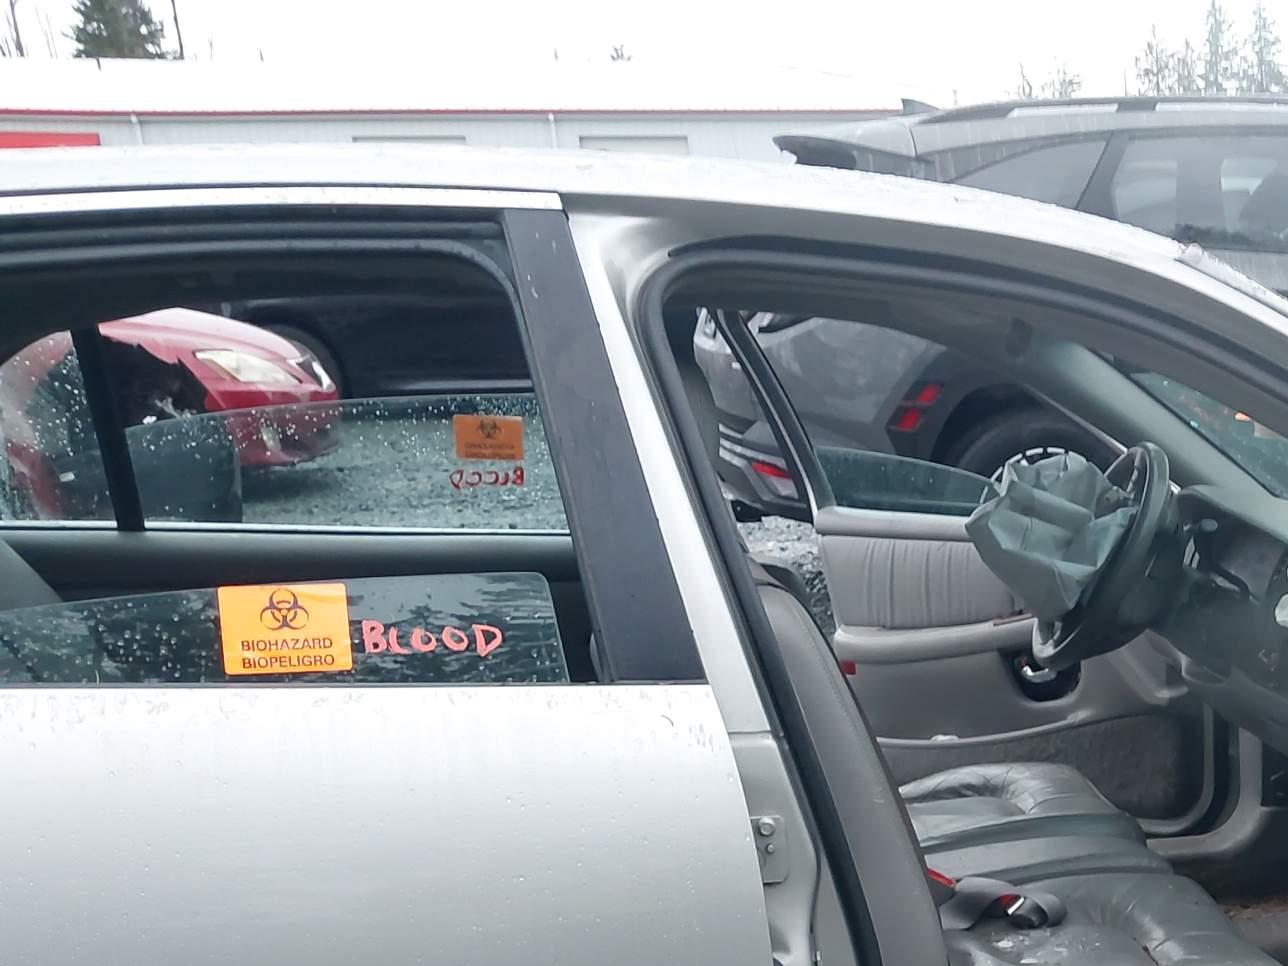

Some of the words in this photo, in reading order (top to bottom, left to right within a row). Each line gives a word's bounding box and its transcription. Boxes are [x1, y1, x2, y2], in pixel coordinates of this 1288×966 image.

[241, 637, 333, 652] BIOHAZARD
[362, 619, 502, 657] BLOOD
[242, 654, 335, 669] BIOPELIGRO
